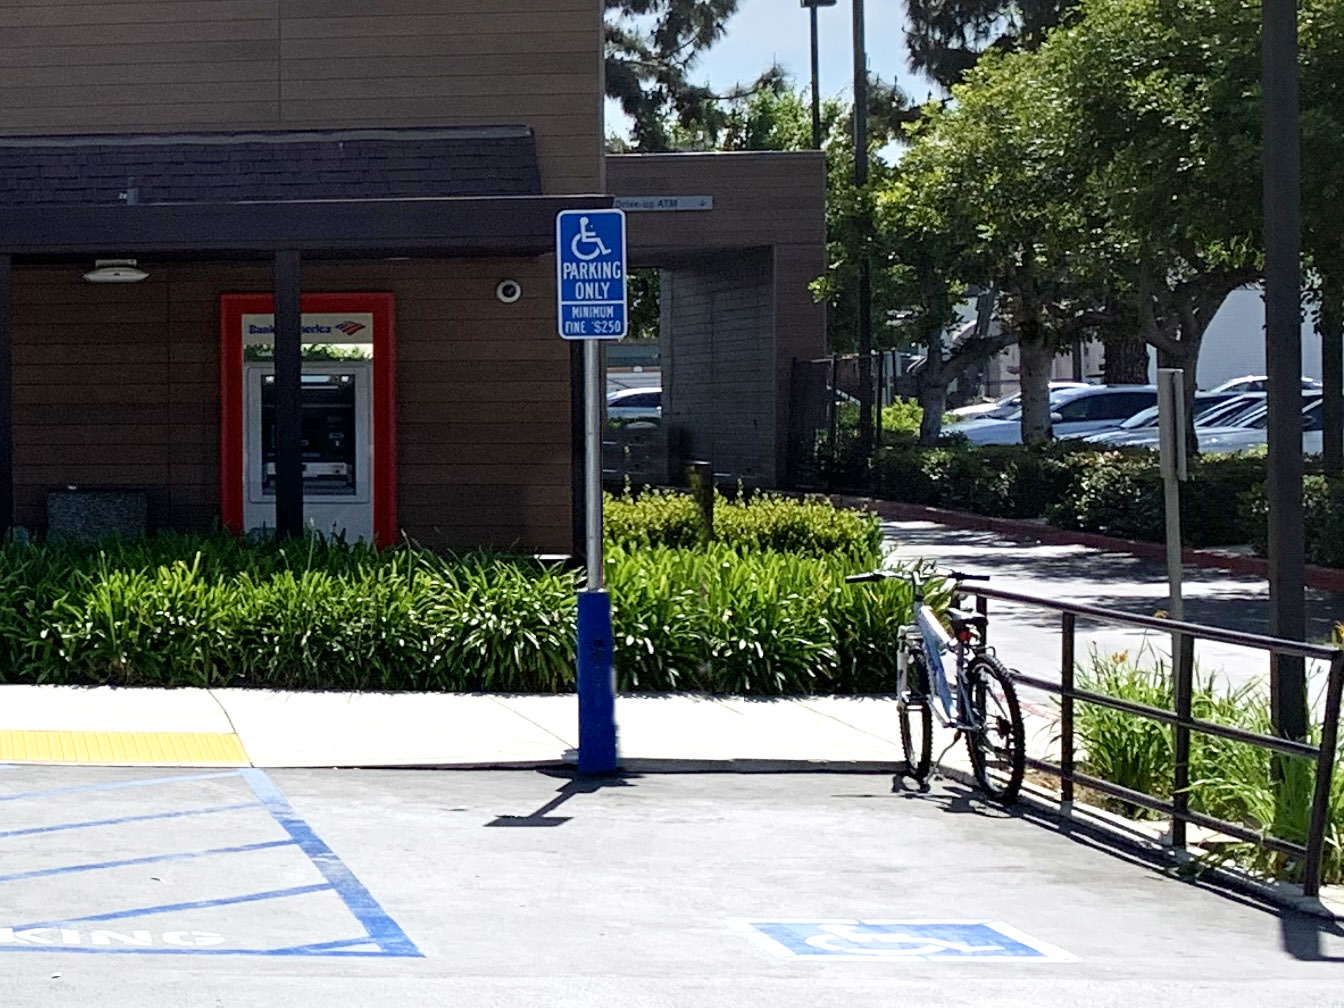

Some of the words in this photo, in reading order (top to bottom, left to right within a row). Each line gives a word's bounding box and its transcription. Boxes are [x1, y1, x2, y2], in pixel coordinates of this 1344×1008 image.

[657, 199, 679, 208] ATM
[563, 261, 621, 280] PARKING
[575, 282, 610, 299] ONLY
[571, 306, 614, 319] MINIMUM
[565, 321, 587, 334] FINE
[592, 321, 621, 333] $250
